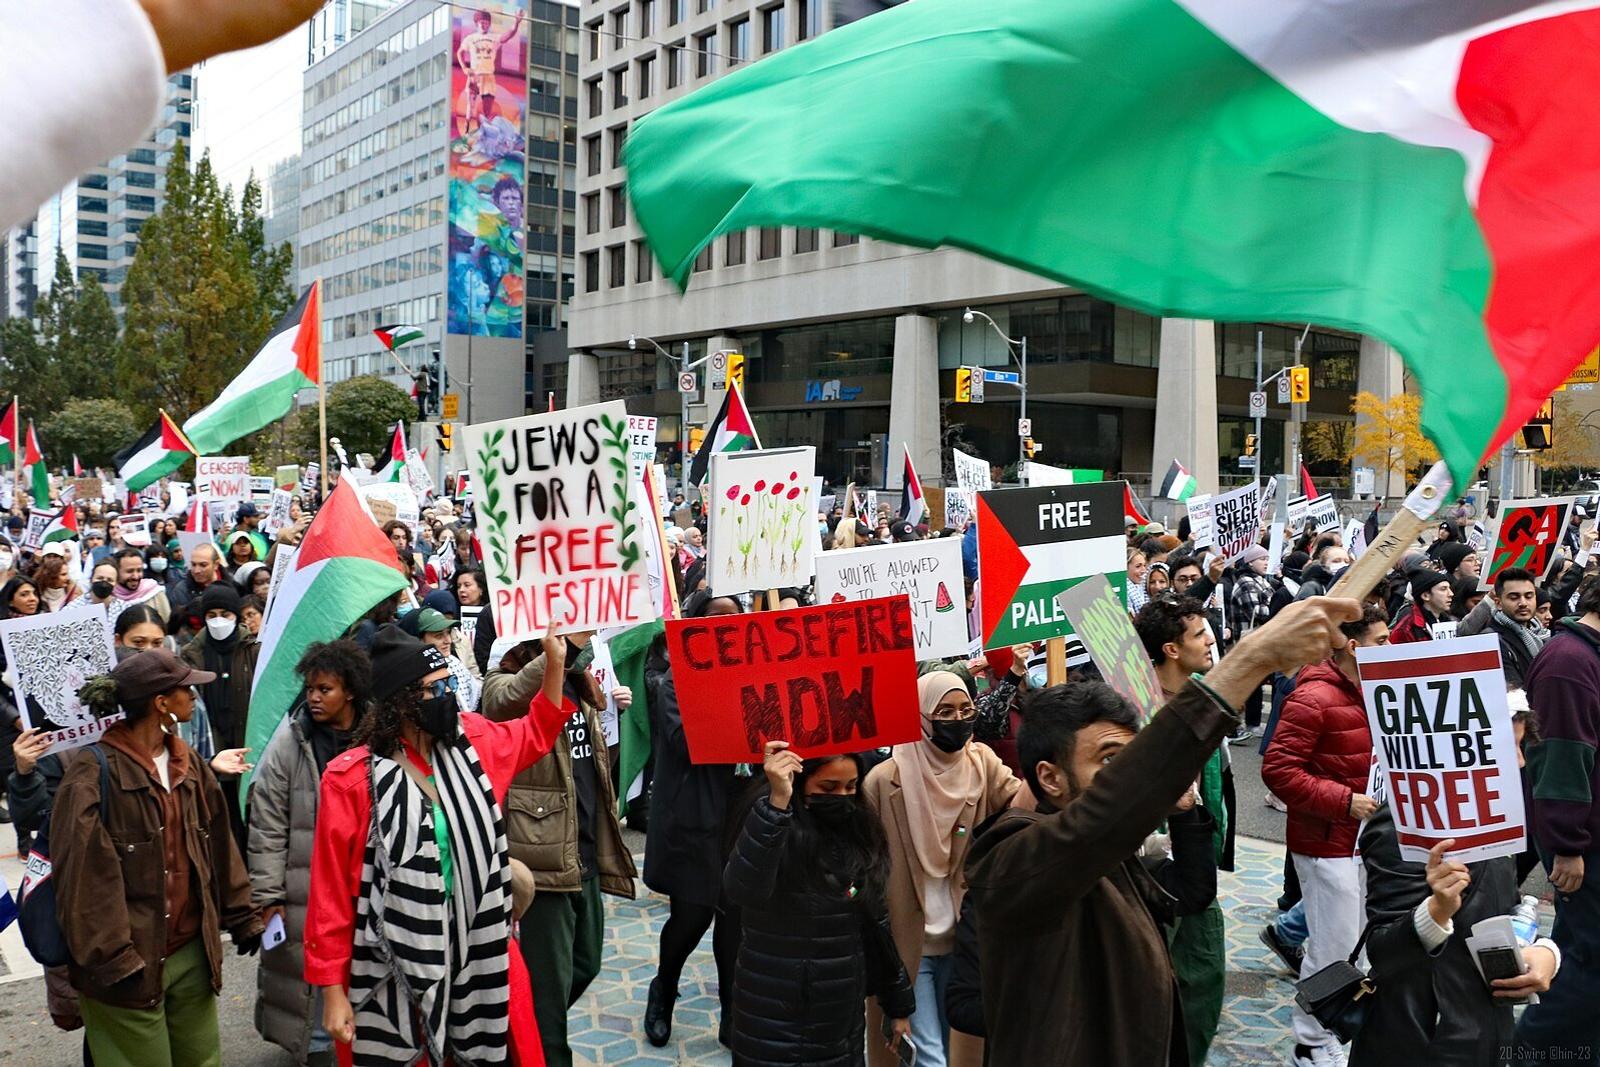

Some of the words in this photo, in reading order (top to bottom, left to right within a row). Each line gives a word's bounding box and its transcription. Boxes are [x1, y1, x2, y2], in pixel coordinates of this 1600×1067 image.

[1572, 369, 1598, 379] OSSING
[629, 417, 656, 431] REE
[502, 418, 600, 476] JEWS
[629, 435, 649, 446] EE
[631, 451, 654, 461] STINE
[199, 461, 249, 475] CEASEFIRE
[210, 478, 245, 497] NOW!
[514, 477, 569, 524] FOR
[586, 468, 606, 516] A
[1214, 498, 1238, 517] END
[1239, 488, 1258, 507] THE
[1038, 500, 1092, 531] FREE
[1216, 501, 1259, 535] SIEGE
[1218, 531, 1234, 547] ON
[1236, 518, 1260, 538] GAZA
[1221, 529, 1256, 559] NOW!
[514, 524, 618, 580] FREE
[838, 563, 878, 588] YOU'RE
[887, 557, 940, 580] ALLOWED
[888, 578, 920, 599] SAY
[496, 574, 640, 638] PALESTINE
[1011, 596, 1066, 630] PALE
[681, 600, 914, 671] CEASEFIRE
[740, 666, 879, 754] NOW
[1373, 677, 1492, 735] GAZA
[46, 715, 121, 742] EASEFIR
[571, 744, 593, 760] CID
[1381, 734, 1445, 770] WILL
[1452, 729, 1497, 768] BE
[1389, 767, 1506, 830] FREE
